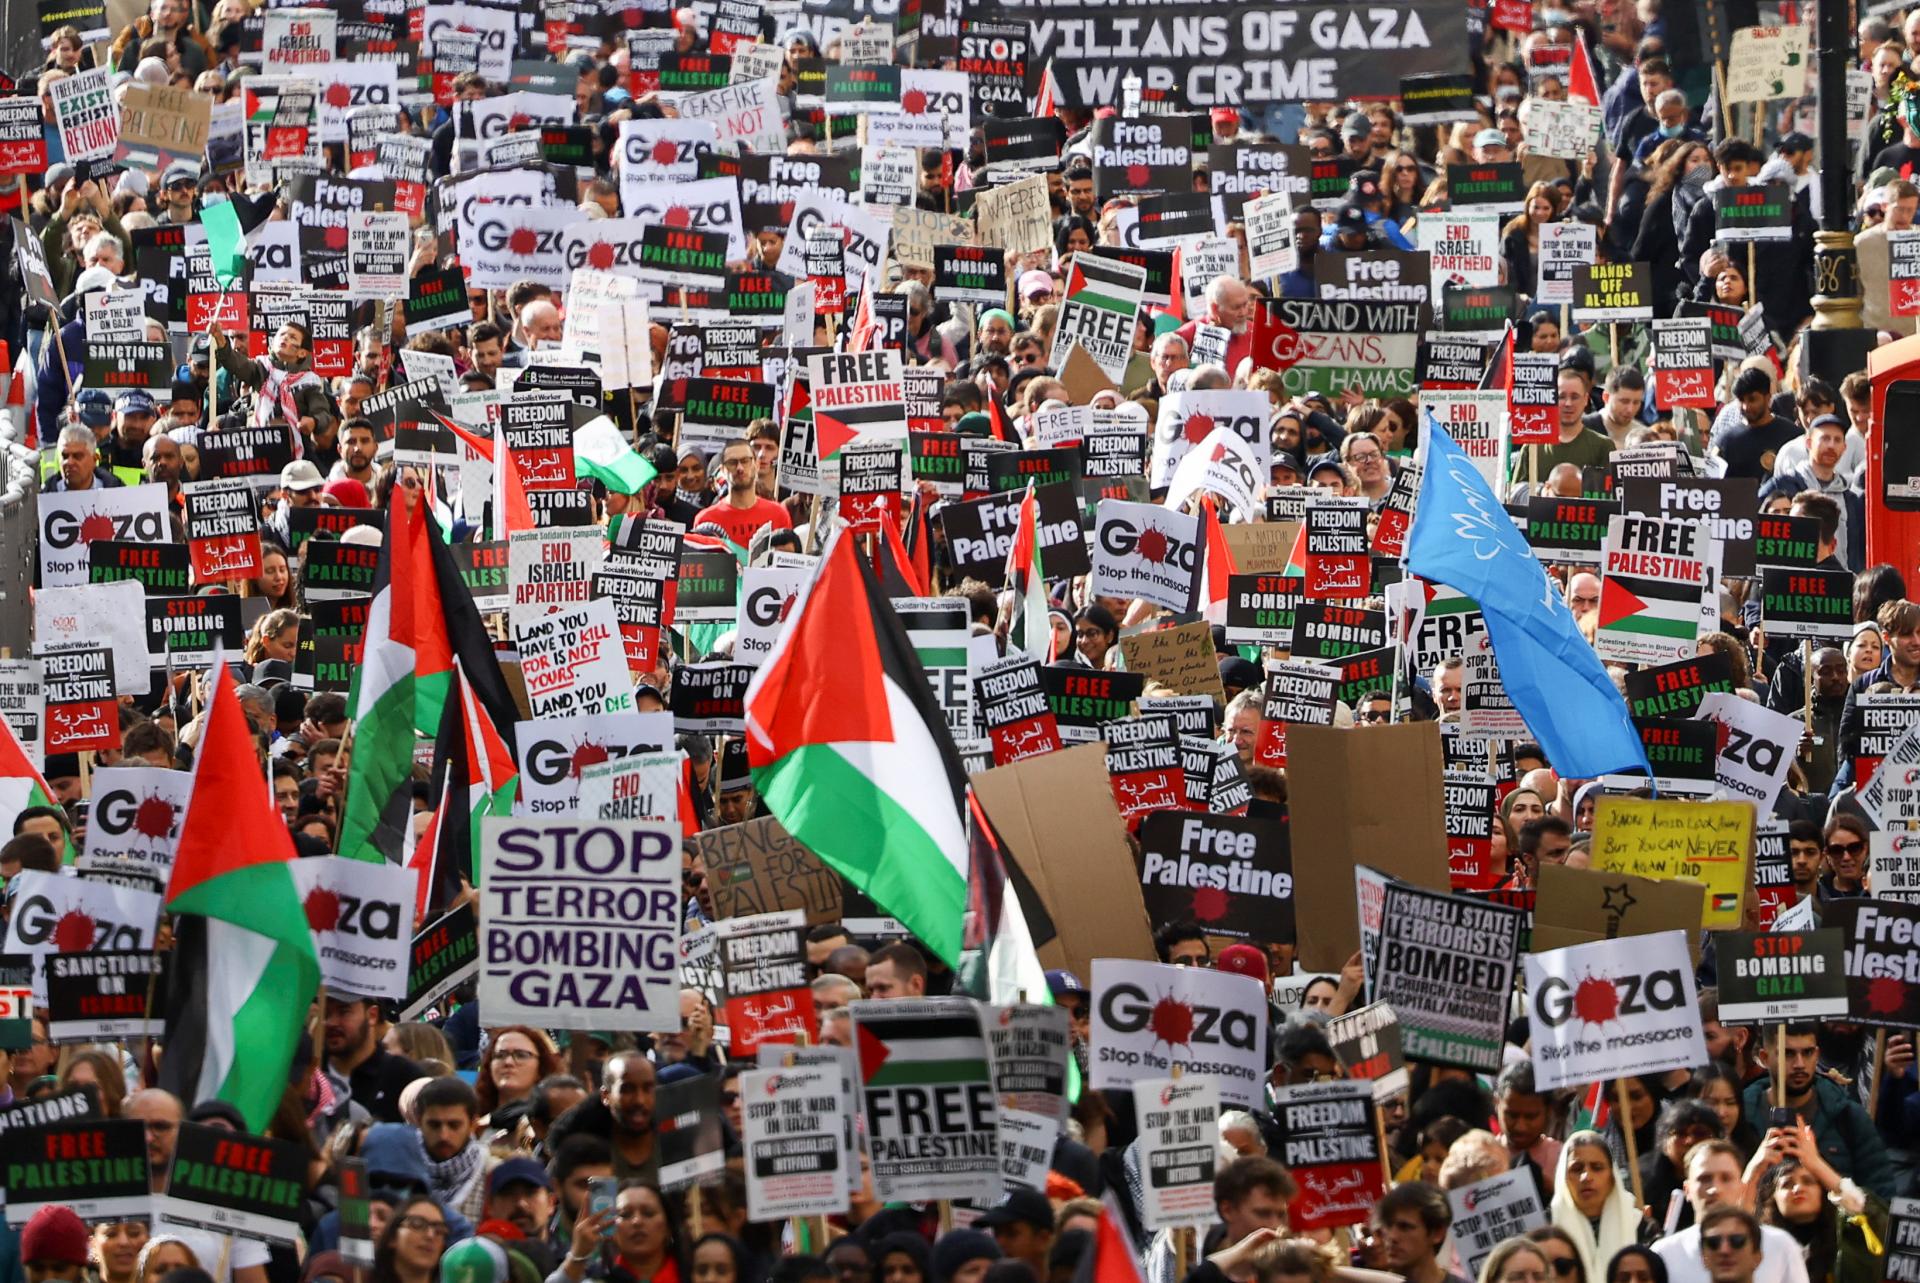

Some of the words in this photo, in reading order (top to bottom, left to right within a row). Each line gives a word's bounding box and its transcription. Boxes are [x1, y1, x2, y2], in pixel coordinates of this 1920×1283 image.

[1030, 16, 1228, 59] VILIANS
[1242, 9, 1298, 52] OF
[1309, 8, 1431, 50] GAZA
[269, 49, 331, 64] APARTHEID
[962, 39, 1025, 61] STOP
[661, 70, 728, 86] PALESTINE
[1187, 58, 1338, 106] CRIME
[58, 88, 111, 116] EXIST!
[61, 105, 113, 129] RESIST!
[727, 106, 764, 137] NOT
[65, 116, 118, 156] RETURN!
[1114, 122, 1161, 144] Free
[1094, 141, 1187, 167] Palestine
[1237, 149, 1286, 170] Free
[770, 158, 819, 181] Free
[666, 232, 702, 251] FREE
[1446, 224, 1470, 240] END
[643, 246, 724, 268] PALESTINE
[1551, 250, 1562, 259] ON
[1564, 249, 1583, 259] GAZA!
[1346, 257, 1400, 280] Free
[1590, 264, 1633, 279] HANDS
[1601, 278, 1623, 293] OFF
[1586, 292, 1639, 306] AL-AQSA
[1060, 302, 1133, 345] FREE
[1264, 301, 1273, 327] I
[1281, 299, 1360, 331] STAND
[1366, 305, 1419, 333] WITH
[705, 328, 756, 346] FREEDOM
[1658, 329, 1706, 346] FREEDOM
[88, 345, 164, 360] SANCTIONS
[704, 349, 760, 366] PALESTINE
[1271, 333, 1387, 365] GAZANS,
[1656, 352, 1710, 368] PALESTINE
[824, 352, 889, 384] FREE
[1277, 367, 1317, 392] OT
[1329, 368, 1413, 394] HAMAS
[712, 385, 748, 401] FREE
[815, 382, 900, 406] PALESTINE
[507, 404, 565, 423] FREEDOM
[1038, 412, 1082, 431] FREE
[1450, 404, 1477, 421] END
[204, 430, 282, 449] SANCTIONS
[506, 429, 570, 448] PALESTINE
[1089, 435, 1139, 453] FREEDOM
[845, 452, 896, 471] FREEDOM
[1086, 459, 1142, 476] PALESTINE
[1617, 460, 1670, 479] FREEDOM
[843, 474, 897, 491] PALESTINE
[192, 490, 248, 511] FREEDOM
[1660, 483, 1721, 511] Free
[1312, 510, 1361, 528] FREEDOM
[1556, 505, 1596, 522] FREE
[44, 506, 164, 549] Gza
[191, 514, 256, 537] PALESTINE
[569, 528, 601, 539] Campaig
[1309, 535, 1365, 552] PALESTINE
[1621, 520, 1696, 557] FREE
[119, 548, 160, 566] FREE
[542, 542, 571, 562] END
[528, 561, 585, 583] ISRAELI
[1318, 559, 1355, 575] الحرية
[1607, 552, 1703, 582] PALESTINE
[516, 581, 592, 602] APARTHEI
[597, 578, 656, 598] FREEDOM
[1257, 577, 1298, 593] STOP
[1313, 575, 1361, 592] لفلسطين
[1789, 577, 1826, 594] FREE
[167, 600, 206, 616] STOP
[1765, 593, 1851, 616] PALESTINE
[152, 615, 225, 634] BOMBING
[515, 621, 554, 643] LAND
[559, 612, 589, 632] YOU
[1323, 608, 1366, 625] STOP
[519, 637, 556, 660] HAVE
[558, 631, 576, 647] TO
[580, 623, 611, 643] KILL
[1305, 622, 1382, 646] BOMBING
[1598, 637, 1626, 647] Palestine
[1627, 640, 1648, 648] Forum
[44, 642, 71, 652] Socialist
[72, 640, 100, 650] Worker
[42, 654, 106, 674] FREEDOM
[522, 654, 550, 675] FOR
[553, 651, 566, 666] IS
[568, 642, 600, 661] NOT
[42, 681, 112, 700] PALESTINE
[982, 667, 1038, 699] FREEDOM
[1065, 676, 1112, 698] FREE
[1272, 671, 1334, 696] FREEDOM
[1656, 667, 1701, 694] FREE
[531, 693, 573, 718] LAND
[575, 682, 607, 704] YOU
[605, 693, 631, 713] DIE
[986, 689, 1048, 727] PALESTINE
[54, 706, 101, 725] الحرية
[1264, 700, 1333, 724] PALESTINE
[1105, 718, 1170, 743] FREEDOM
[1642, 728, 1680, 745] FREE
[1105, 747, 1178, 771] PALESTINE
[612, 774, 640, 800] END
[1180, 819, 1257, 860] Free
[1686, 835, 1739, 857] NEVER
[495, 828, 673, 875] STOP
[1142, 852, 1293, 899] Palestine
[1681, 863, 1702, 876] DID
[488, 886, 678, 920] TERROR
[728, 930, 798, 958] FREEDOM
[1389, 913, 1513, 961] TERRORISTS
[1753, 936, 1804, 956] STOP
[487, 928, 676, 970] BOMBING
[54, 956, 162, 976] SANCTIONS
[1385, 942, 1506, 992] BOMBED
[1736, 955, 1826, 977] BOMBING
[729, 963, 806, 993] PALESTINE
[1756, 977, 1804, 994] GAZA
[509, 972, 650, 1011] GAZA
[1535, 968, 1687, 1027] Gza
[1099, 982, 1257, 1052] Gza
[1574, 1036, 1601, 1058] the
[1606, 1026, 1694, 1051] massacre
[1100, 1047, 1140, 1068] Stop
[1143, 1052, 1168, 1070] the
[1172, 1056, 1256, 1081] massacre
[748, 1102, 776, 1119] STOP
[781, 1098, 803, 1114] THE
[807, 1096, 836, 1112] WAR
[865, 1085, 995, 1135] FREE
[1286, 1101, 1367, 1130] FREEDOM
[46, 1132, 106, 1160] FREE
[214, 1139, 273, 1174] FREE
[1286, 1136, 1376, 1165] PALESTINE
[8, 1157, 146, 1191] PALESTINE
